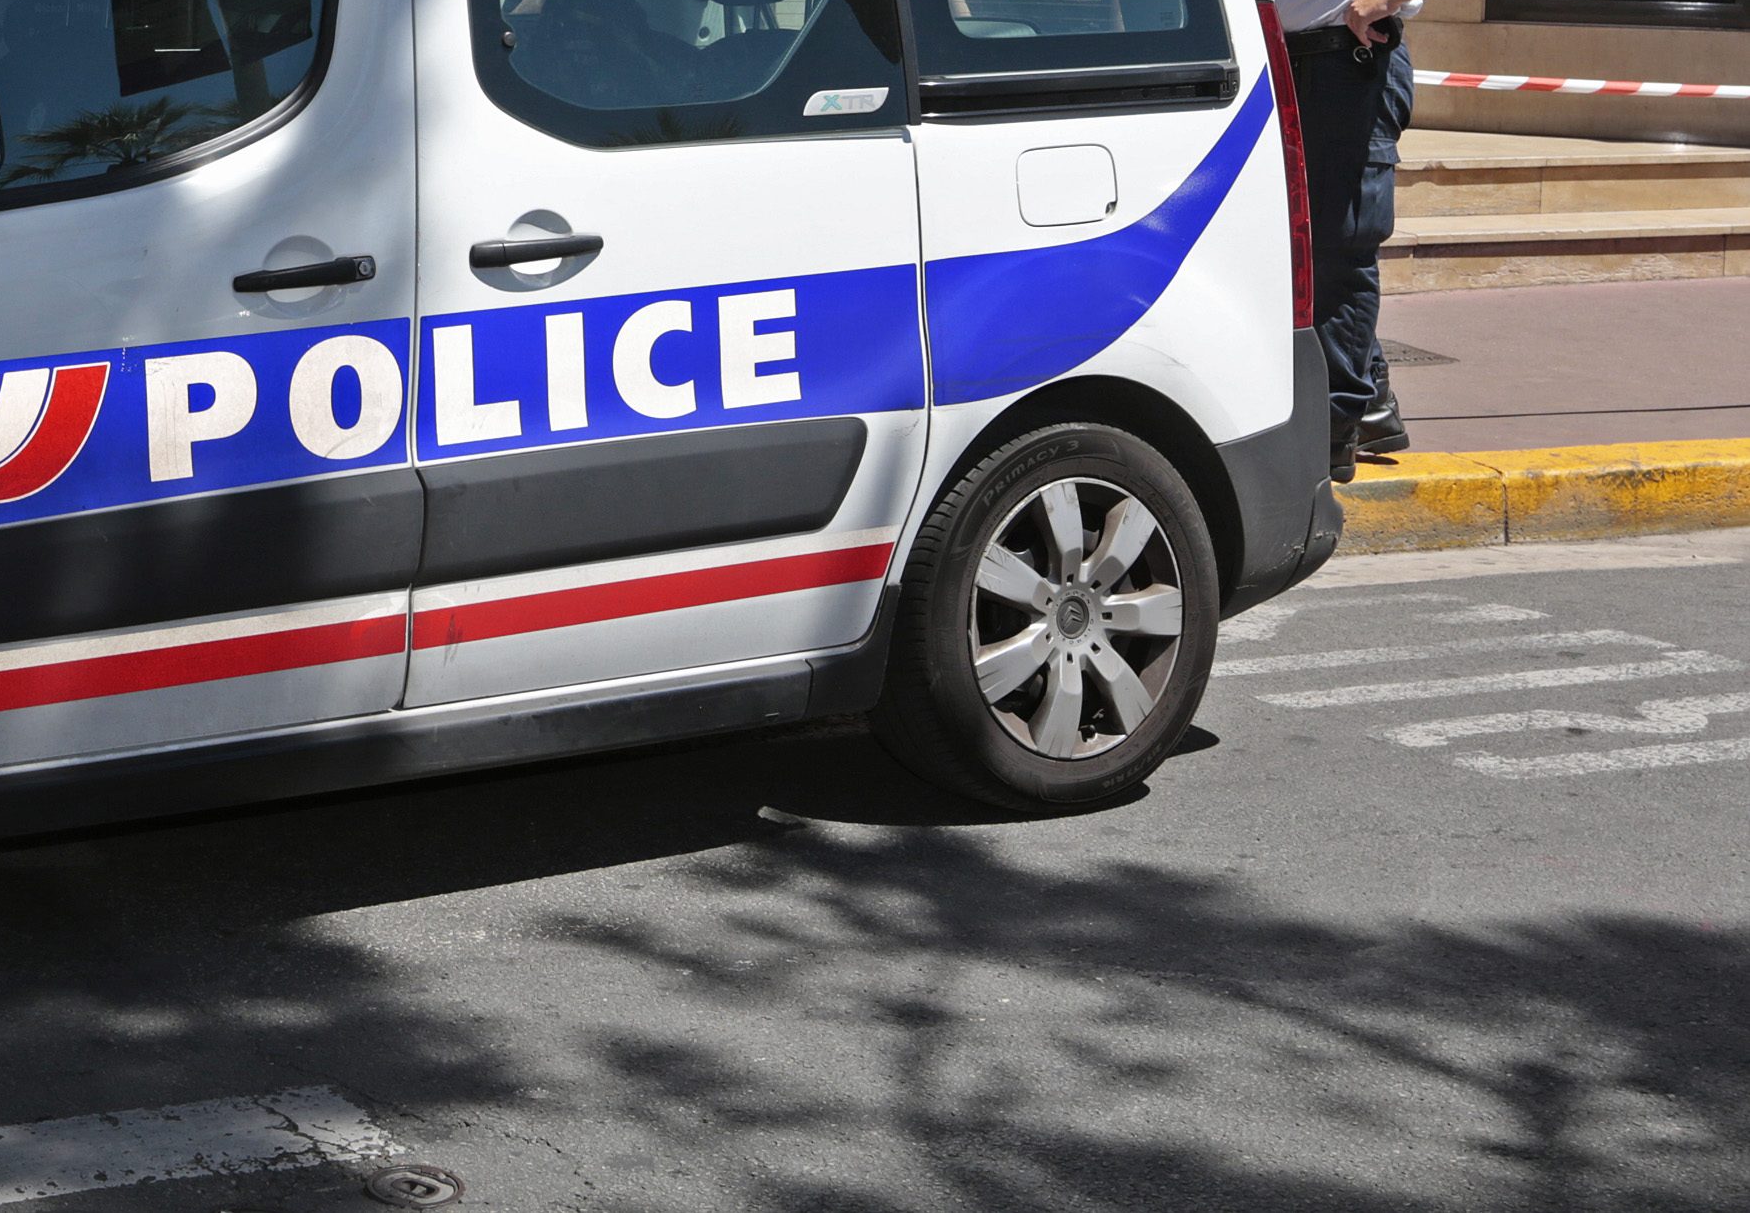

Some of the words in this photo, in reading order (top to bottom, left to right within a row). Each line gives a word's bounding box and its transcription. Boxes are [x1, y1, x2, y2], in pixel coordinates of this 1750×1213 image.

[820, 93, 876, 112] XTR
[144, 288, 802, 483] POLICE
[982, 446, 1059, 506] PRIMACY
